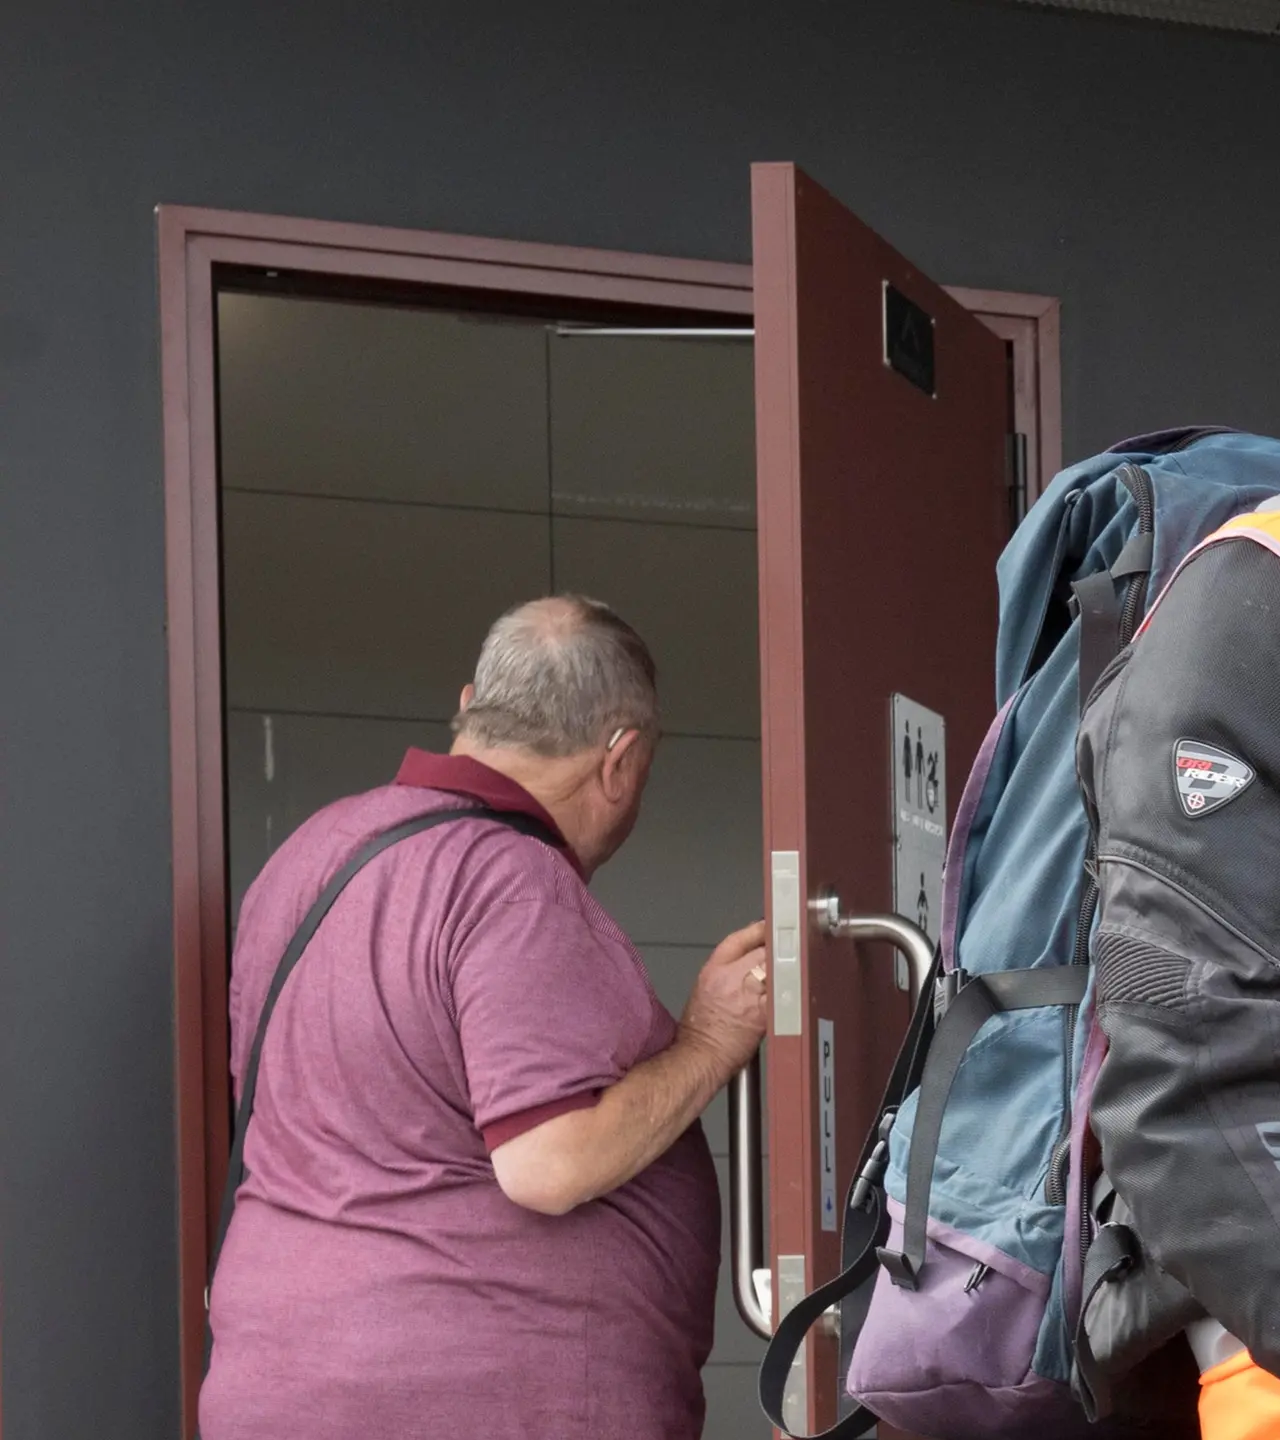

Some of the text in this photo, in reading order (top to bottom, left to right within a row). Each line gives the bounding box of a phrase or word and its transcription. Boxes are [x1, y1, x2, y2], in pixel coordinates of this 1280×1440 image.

[1177, 757, 1213, 771] DRI
[1184, 768, 1246, 788] RIDER
[823, 1039, 831, 1174] PULL
